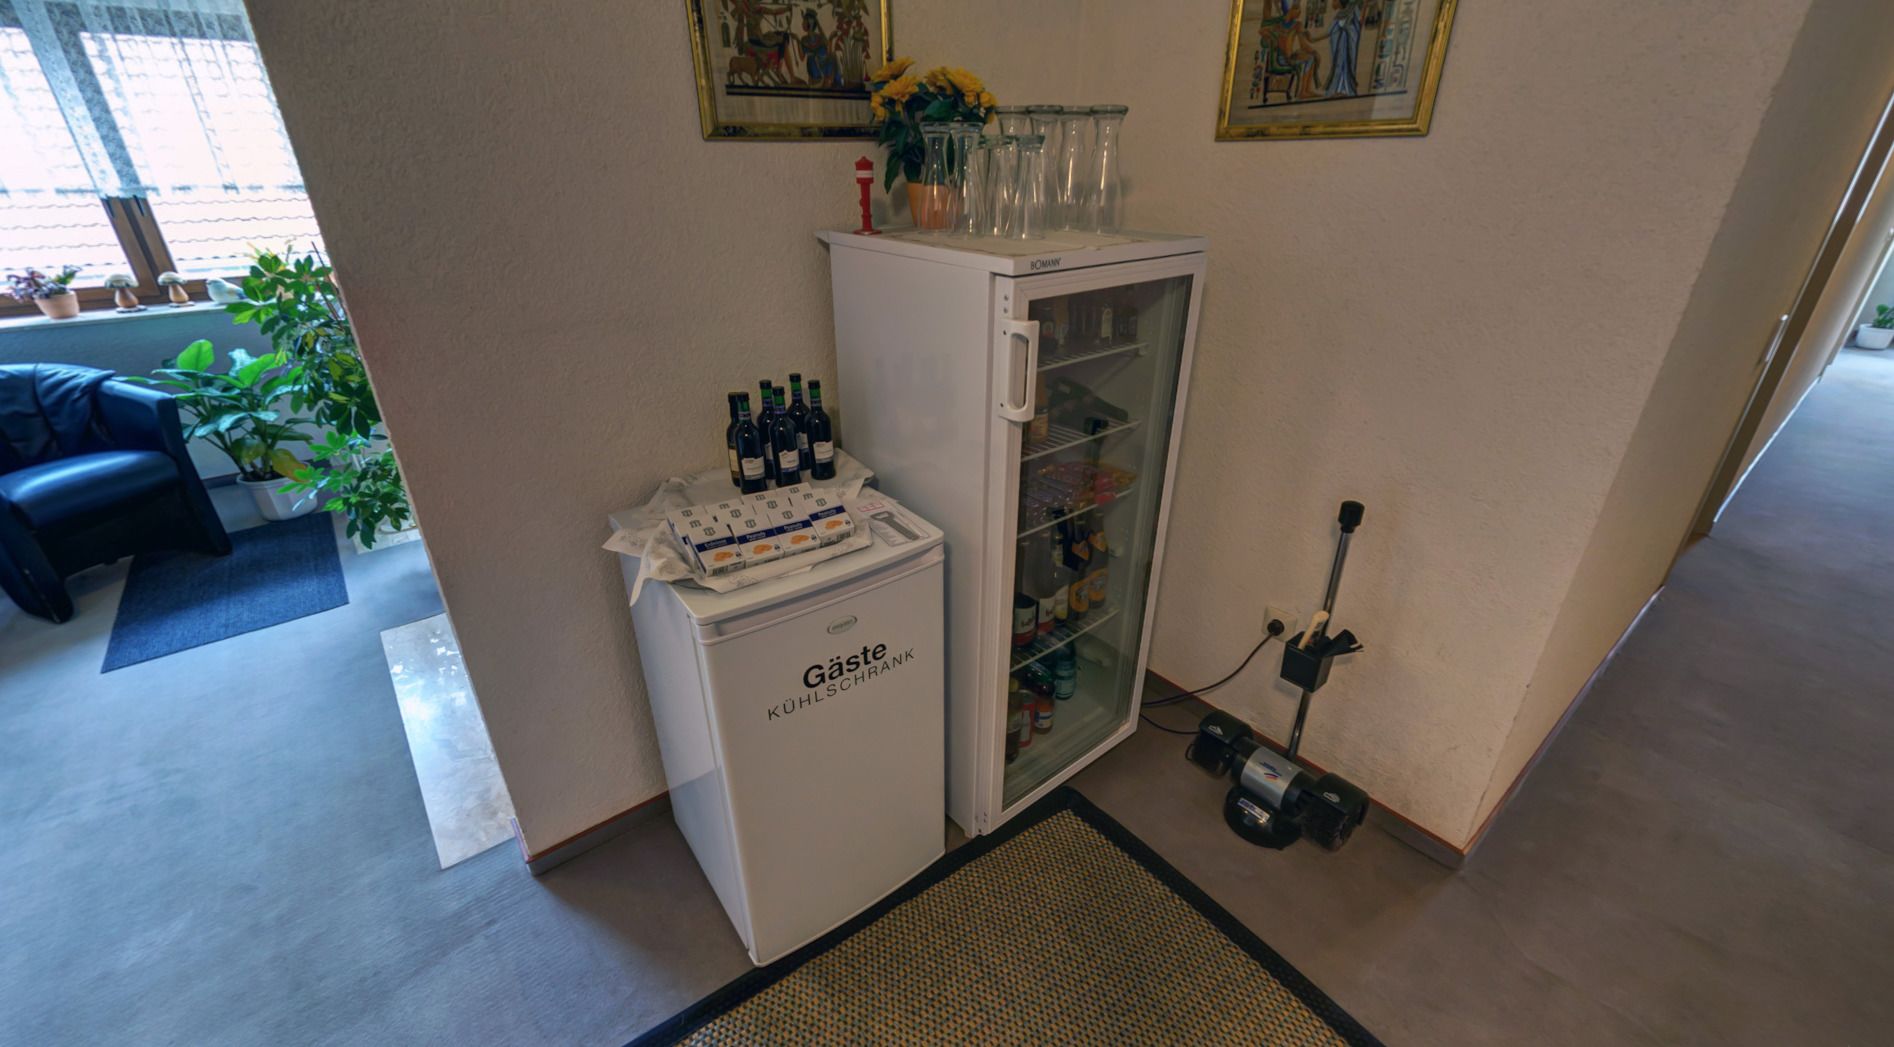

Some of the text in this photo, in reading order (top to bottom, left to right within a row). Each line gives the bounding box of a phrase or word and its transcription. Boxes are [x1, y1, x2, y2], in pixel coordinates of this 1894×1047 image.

[1030, 257, 1062, 270] BOMANN
[767, 648, 915, 721] KÜHLSCHRANK
[802, 642, 888, 689] Gäste
